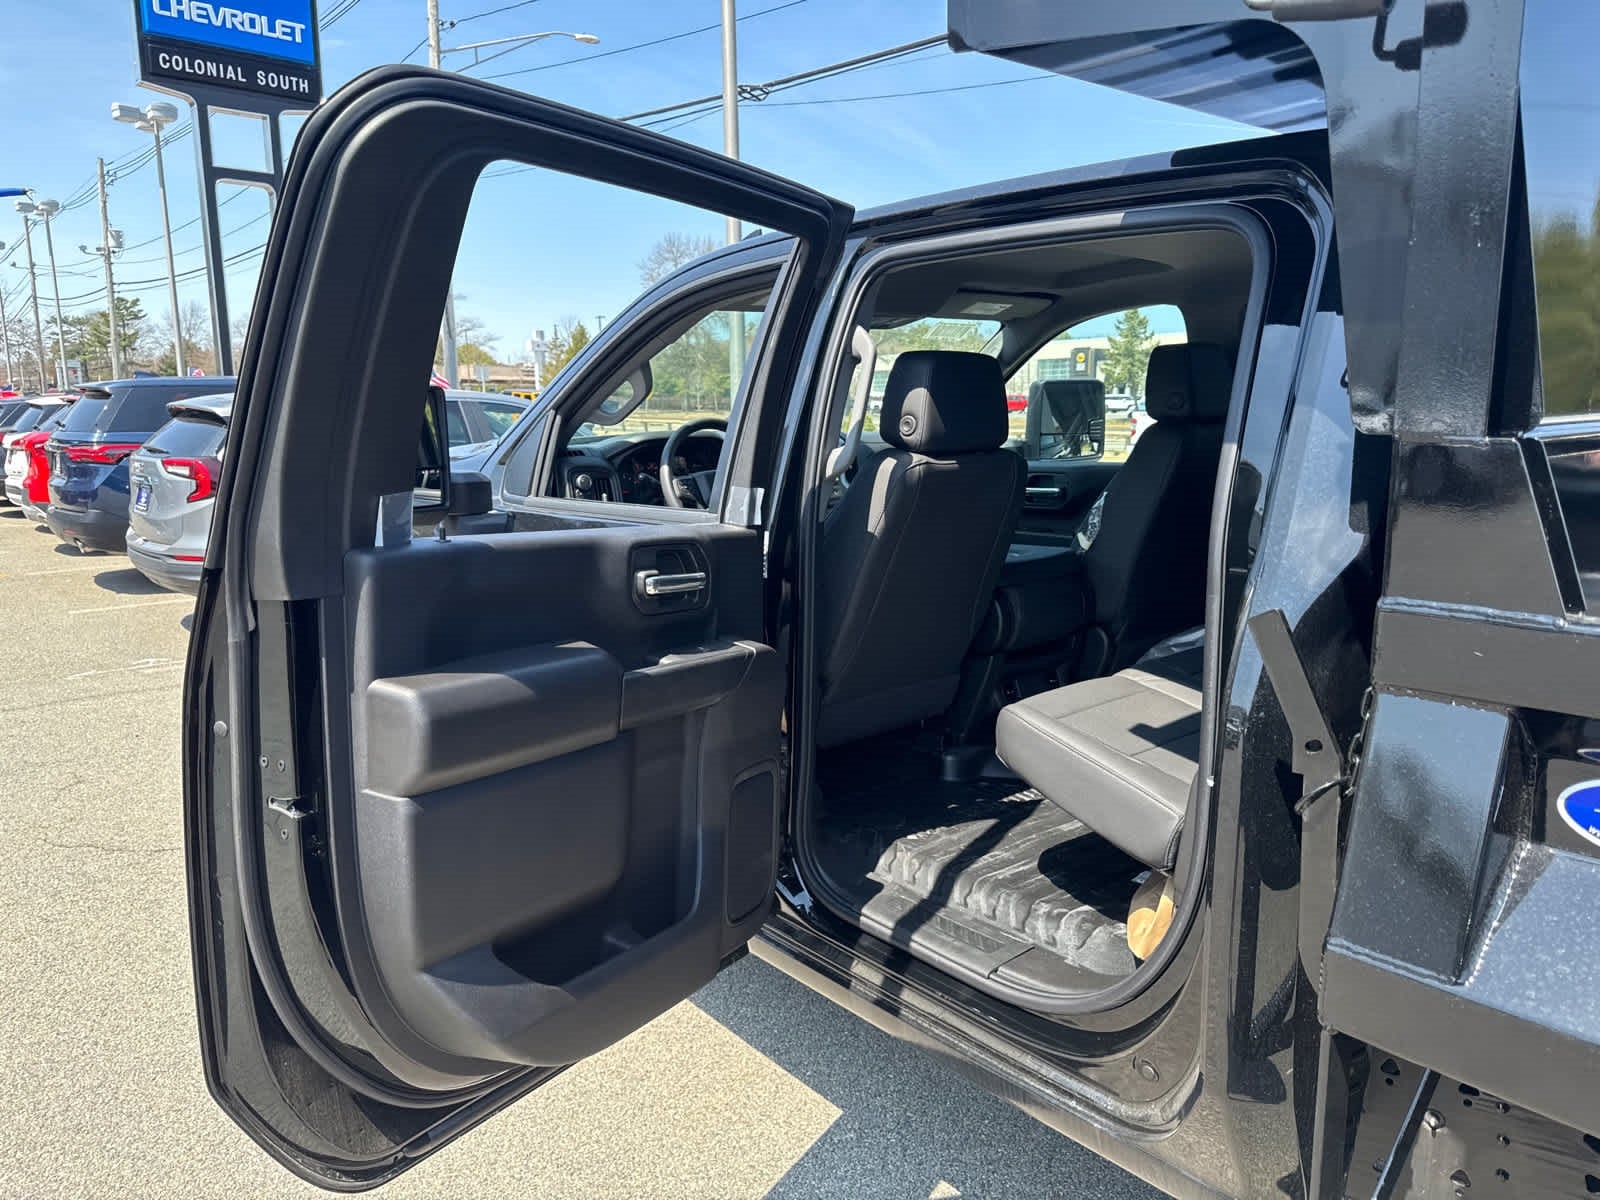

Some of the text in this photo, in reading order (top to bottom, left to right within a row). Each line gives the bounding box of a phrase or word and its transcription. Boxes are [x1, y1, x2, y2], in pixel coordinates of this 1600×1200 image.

[152, 0, 306, 43] CHEVROLET
[158, 52, 309, 93] COLONIAL SOUTH
